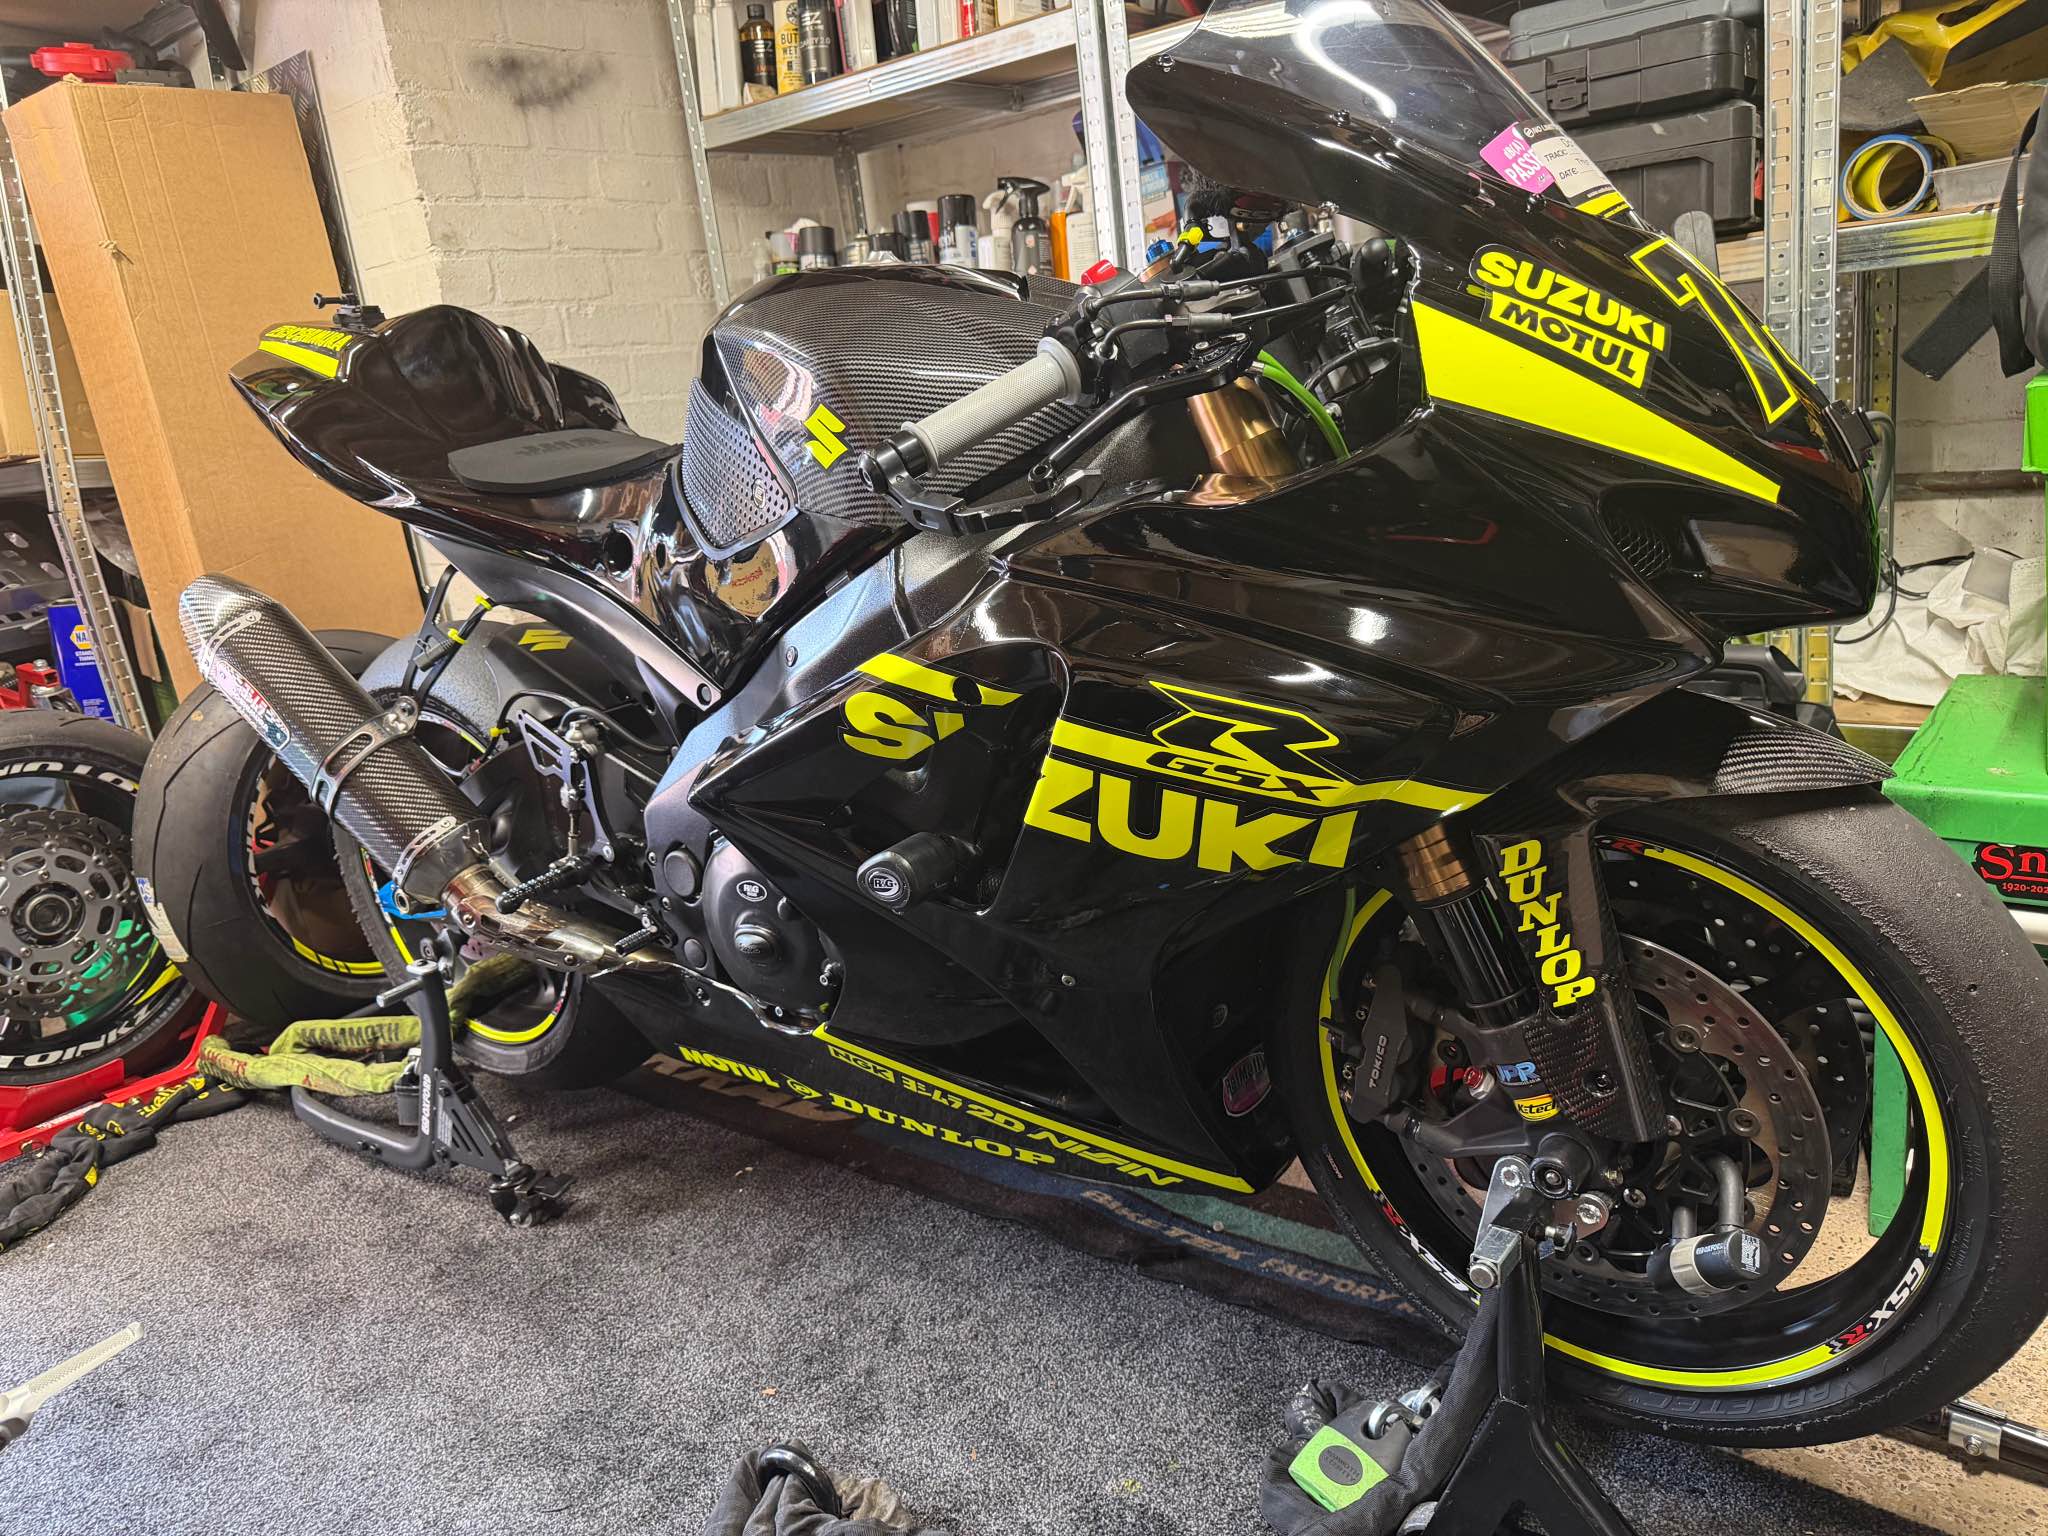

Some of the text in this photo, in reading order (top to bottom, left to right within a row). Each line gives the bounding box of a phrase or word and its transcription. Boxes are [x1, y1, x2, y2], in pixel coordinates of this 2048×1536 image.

[1477, 251, 1667, 351] SUZUKI
[1499, 301, 1638, 379] MOTUL
[1146, 750, 1341, 802] GSX
[1499, 839, 1596, 1008] DUNLOP
[300, 1022, 400, 1046] MAMMOTH
[831, 1047, 892, 1081] NGK
[1368, 1034, 1389, 1089] TOKICO
[678, 1045, 780, 1088] MOTUL
[828, 1091, 1056, 1164] DUNLOP
[965, 1103, 1026, 1133] 2D
[1839, 1257, 1925, 1345] GSX-R
